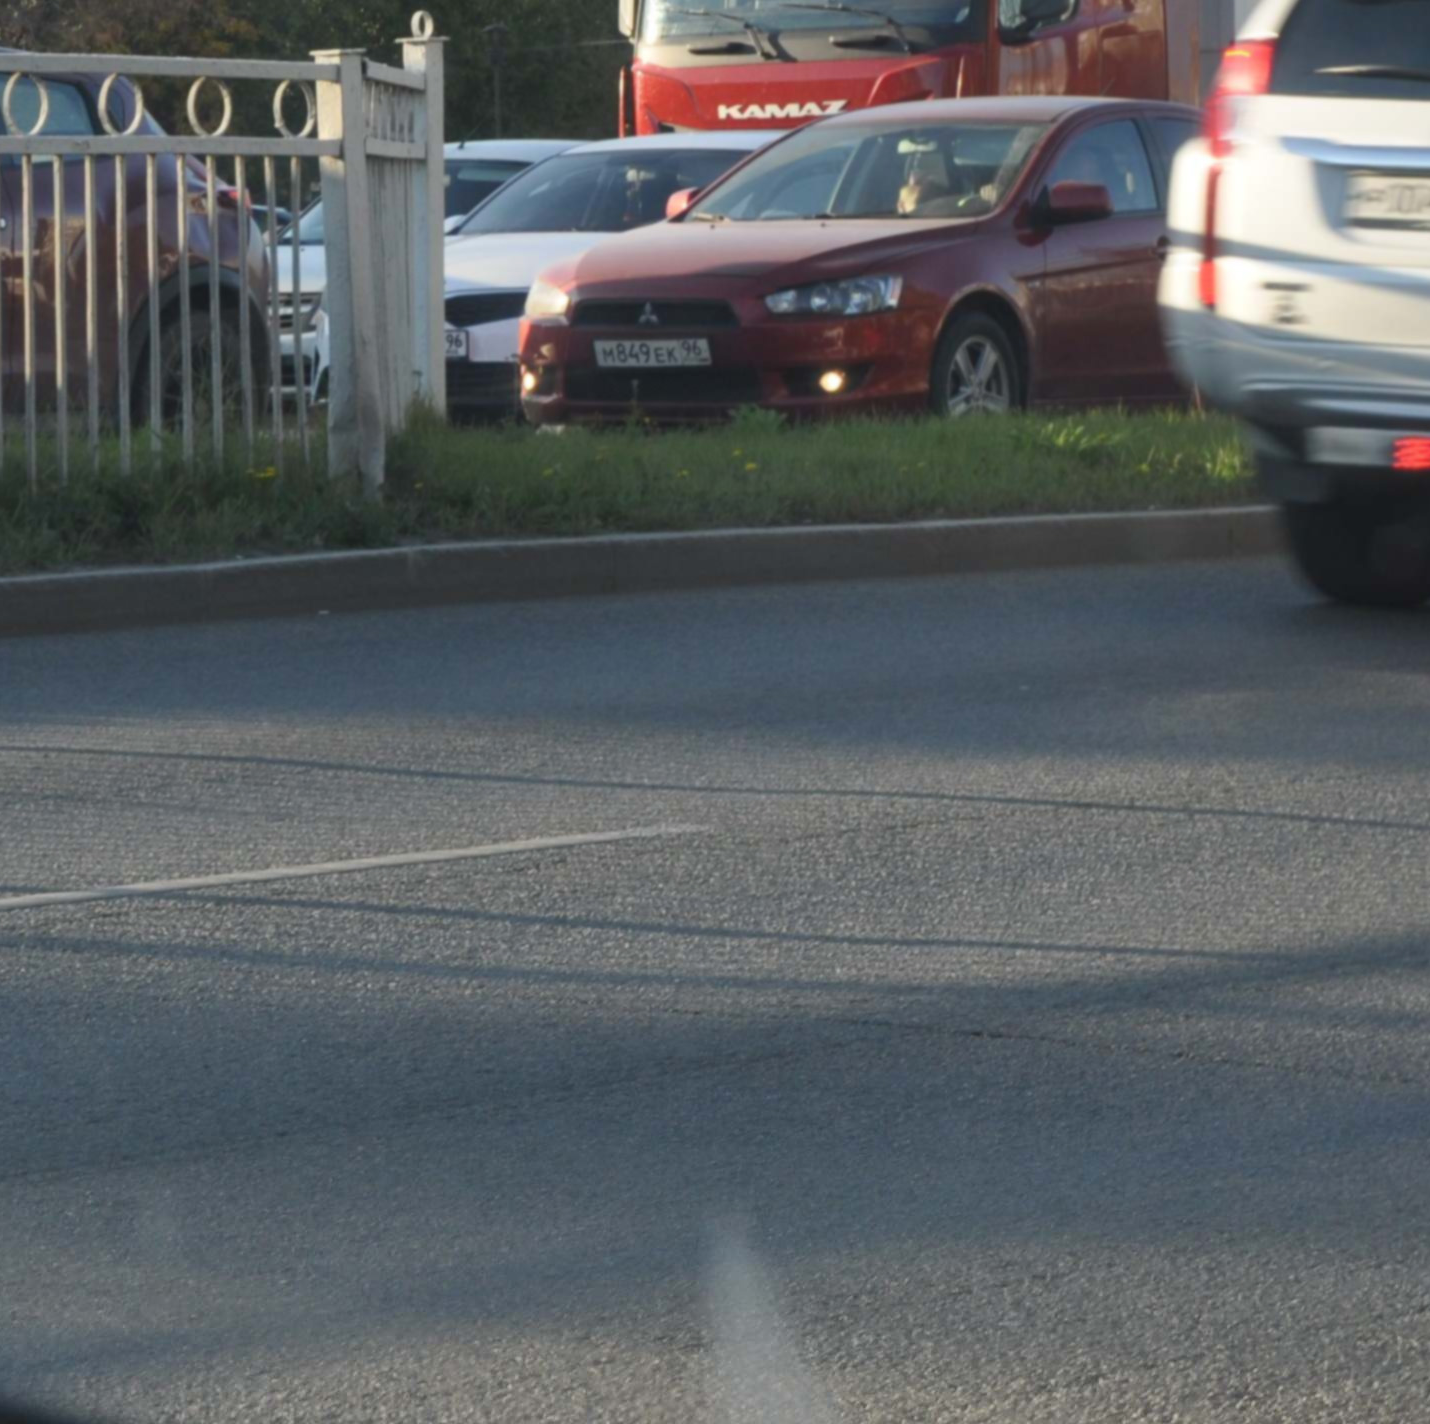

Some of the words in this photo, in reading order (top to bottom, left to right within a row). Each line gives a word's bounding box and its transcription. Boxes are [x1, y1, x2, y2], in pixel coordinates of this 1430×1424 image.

[717, 98, 848, 120] KAMAZ
[602, 341, 679, 364] М849ЕК
[681, 339, 702, 357] 96
